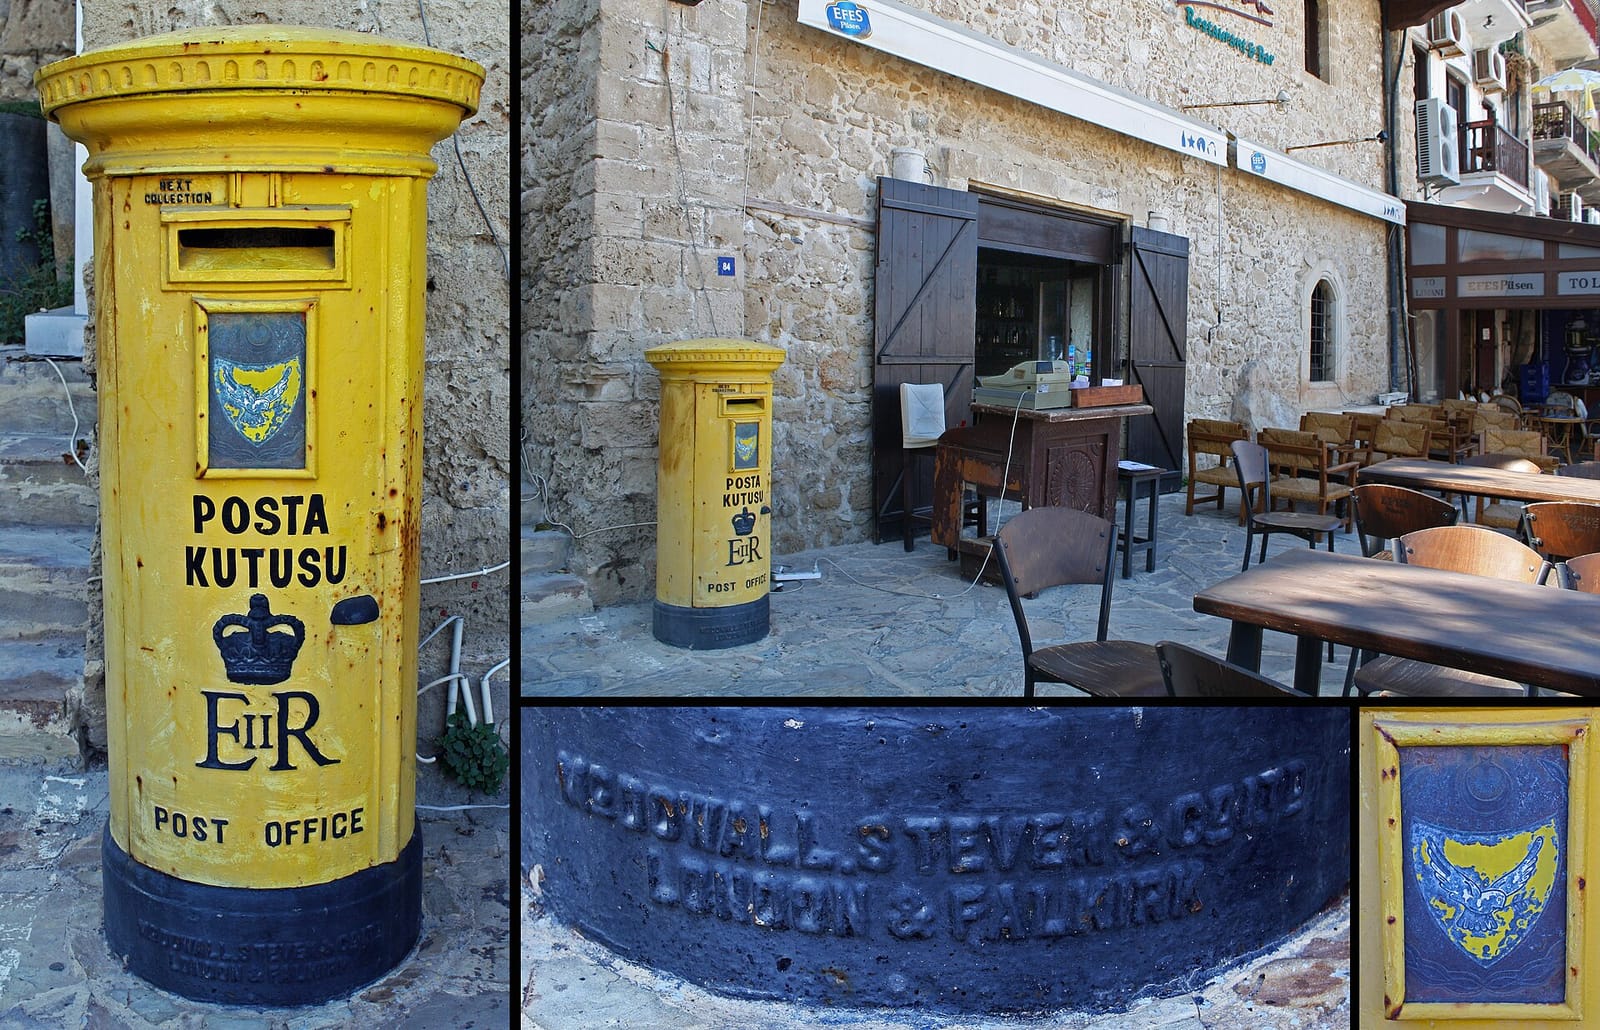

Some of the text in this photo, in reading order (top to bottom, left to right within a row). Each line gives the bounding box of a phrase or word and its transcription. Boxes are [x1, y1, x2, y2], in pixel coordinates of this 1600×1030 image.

[833, 7, 863, 22] EFES
[160, 180, 192, 191] NEXT
[145, 192, 212, 204] COLLECTION
[722, 262, 731, 271] 84
[1569, 278, 1588, 289] TO
[726, 475, 760, 490] POSTA
[723, 490, 763, 507] KUTUSU
[193, 494, 329, 535] POSTA
[186, 546, 347, 588] KUTUSU
[708, 574, 766, 592] POST OFFICE
[155, 806, 364, 847] POST OFFICE
